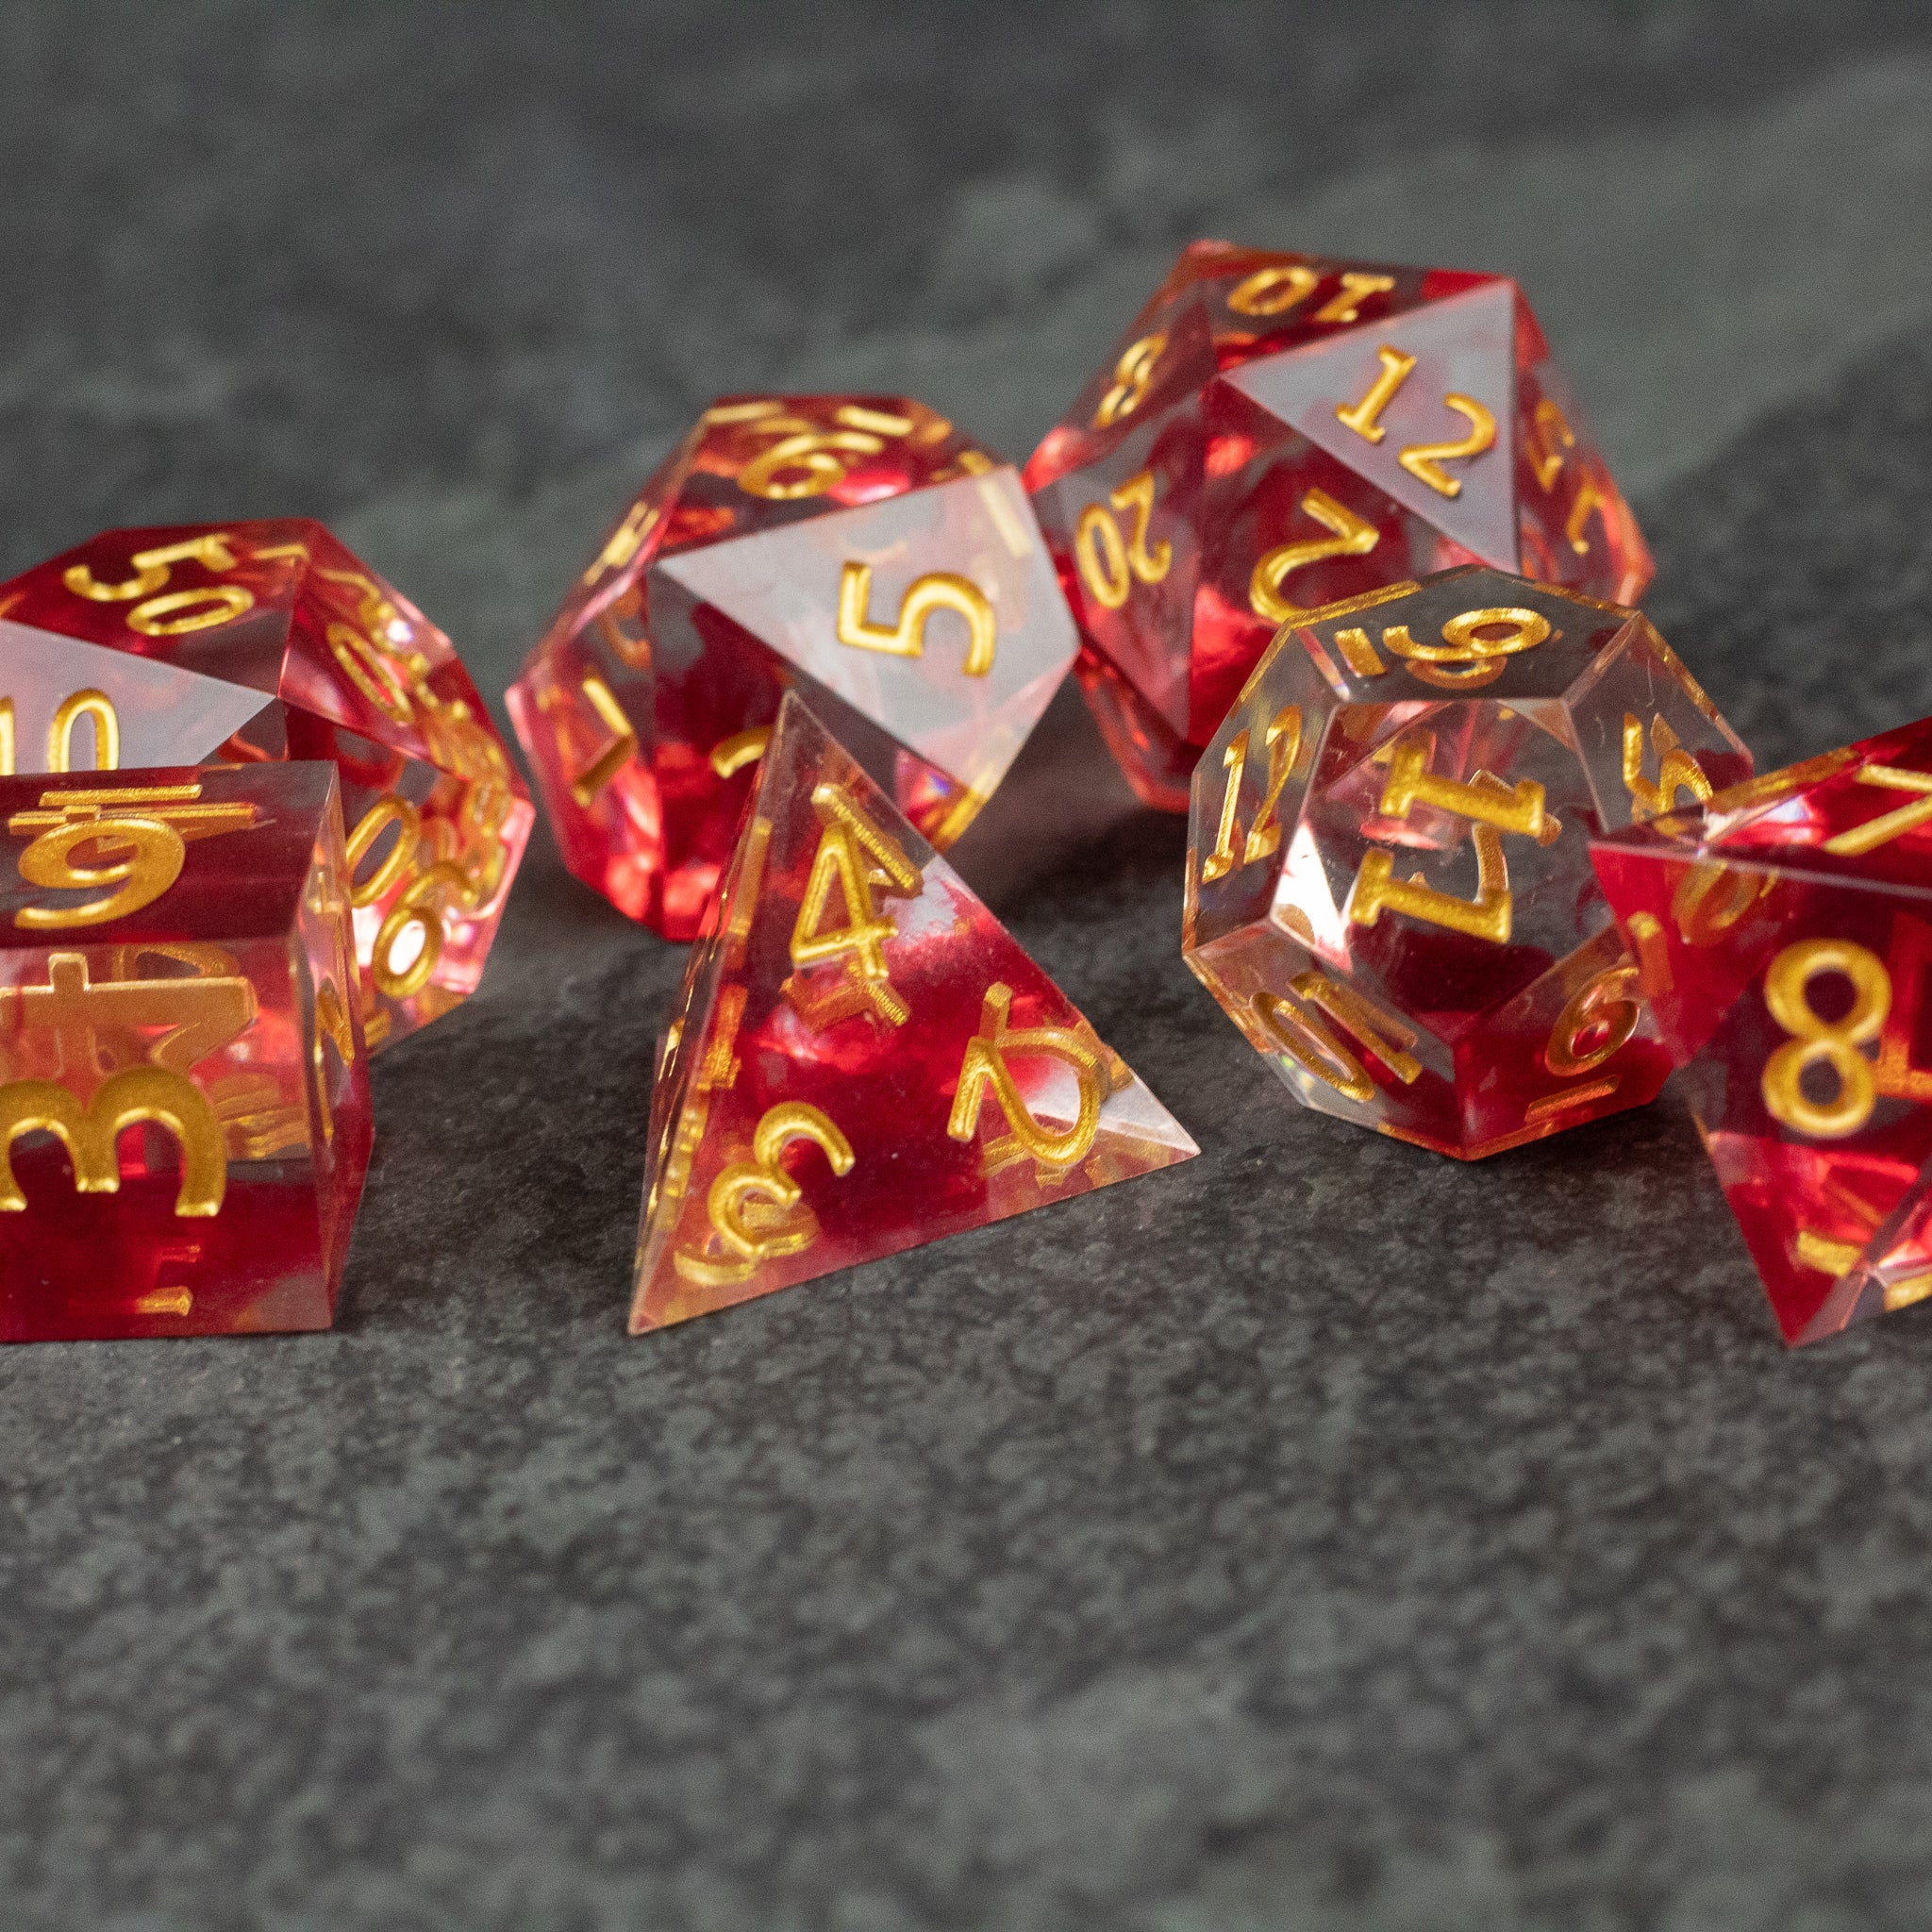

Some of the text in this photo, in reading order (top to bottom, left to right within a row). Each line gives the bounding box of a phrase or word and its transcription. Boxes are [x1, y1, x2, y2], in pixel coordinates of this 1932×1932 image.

[1228, 265, 1394, 323] 10
[1336, 343, 1498, 500] 12
[836, 559, 996, 678] 5
[1074, 472, 1172, 609] 20
[1202, 704, 1303, 884] 12
[790, 824, 899, 983] 4
[1760, 938, 1891, 1139] 8
